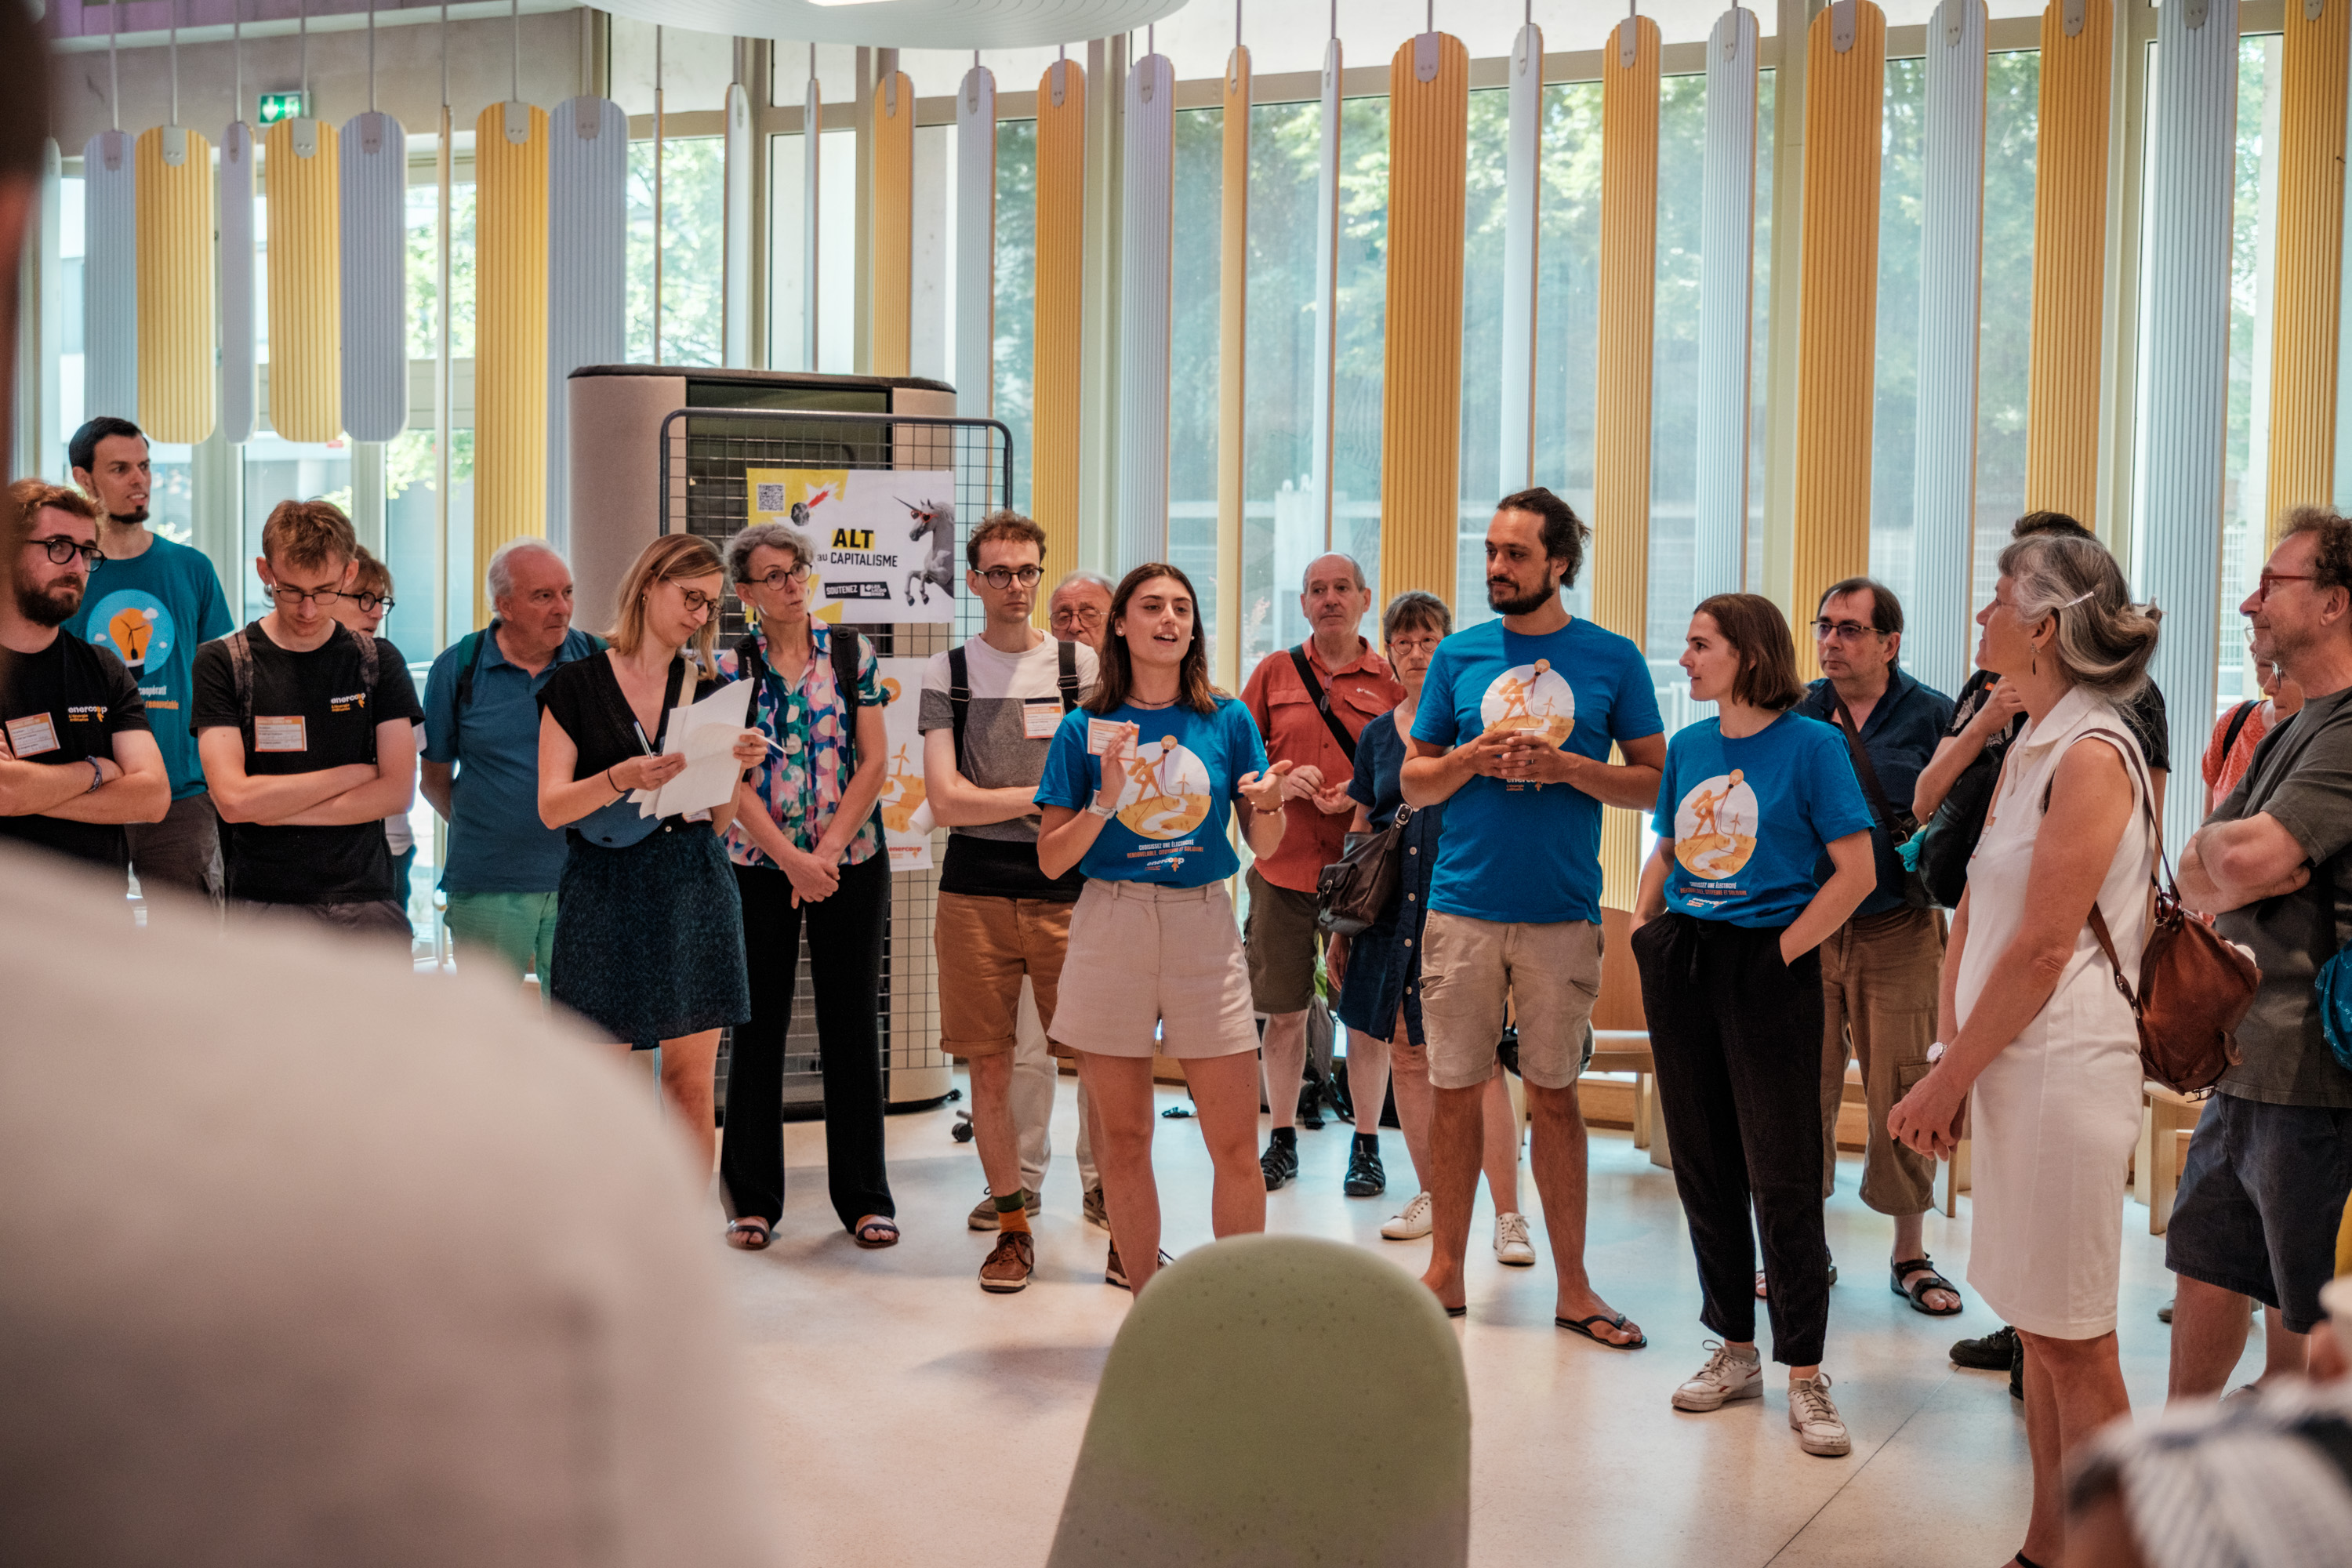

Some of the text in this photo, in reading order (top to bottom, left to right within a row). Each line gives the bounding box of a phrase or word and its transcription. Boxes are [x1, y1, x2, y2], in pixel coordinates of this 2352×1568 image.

[833, 528, 874, 549] ALT
[817, 552, 898, 568] au CAPITALISME
[826, 584, 858, 595] SOUTENEZ
[331, 692, 366, 705] enercoop
[67, 706, 108, 714] enercoop
[1171, 838, 1194, 848] ÉLECTRICITÉ
[1146, 856, 1185, 866] enercoop
